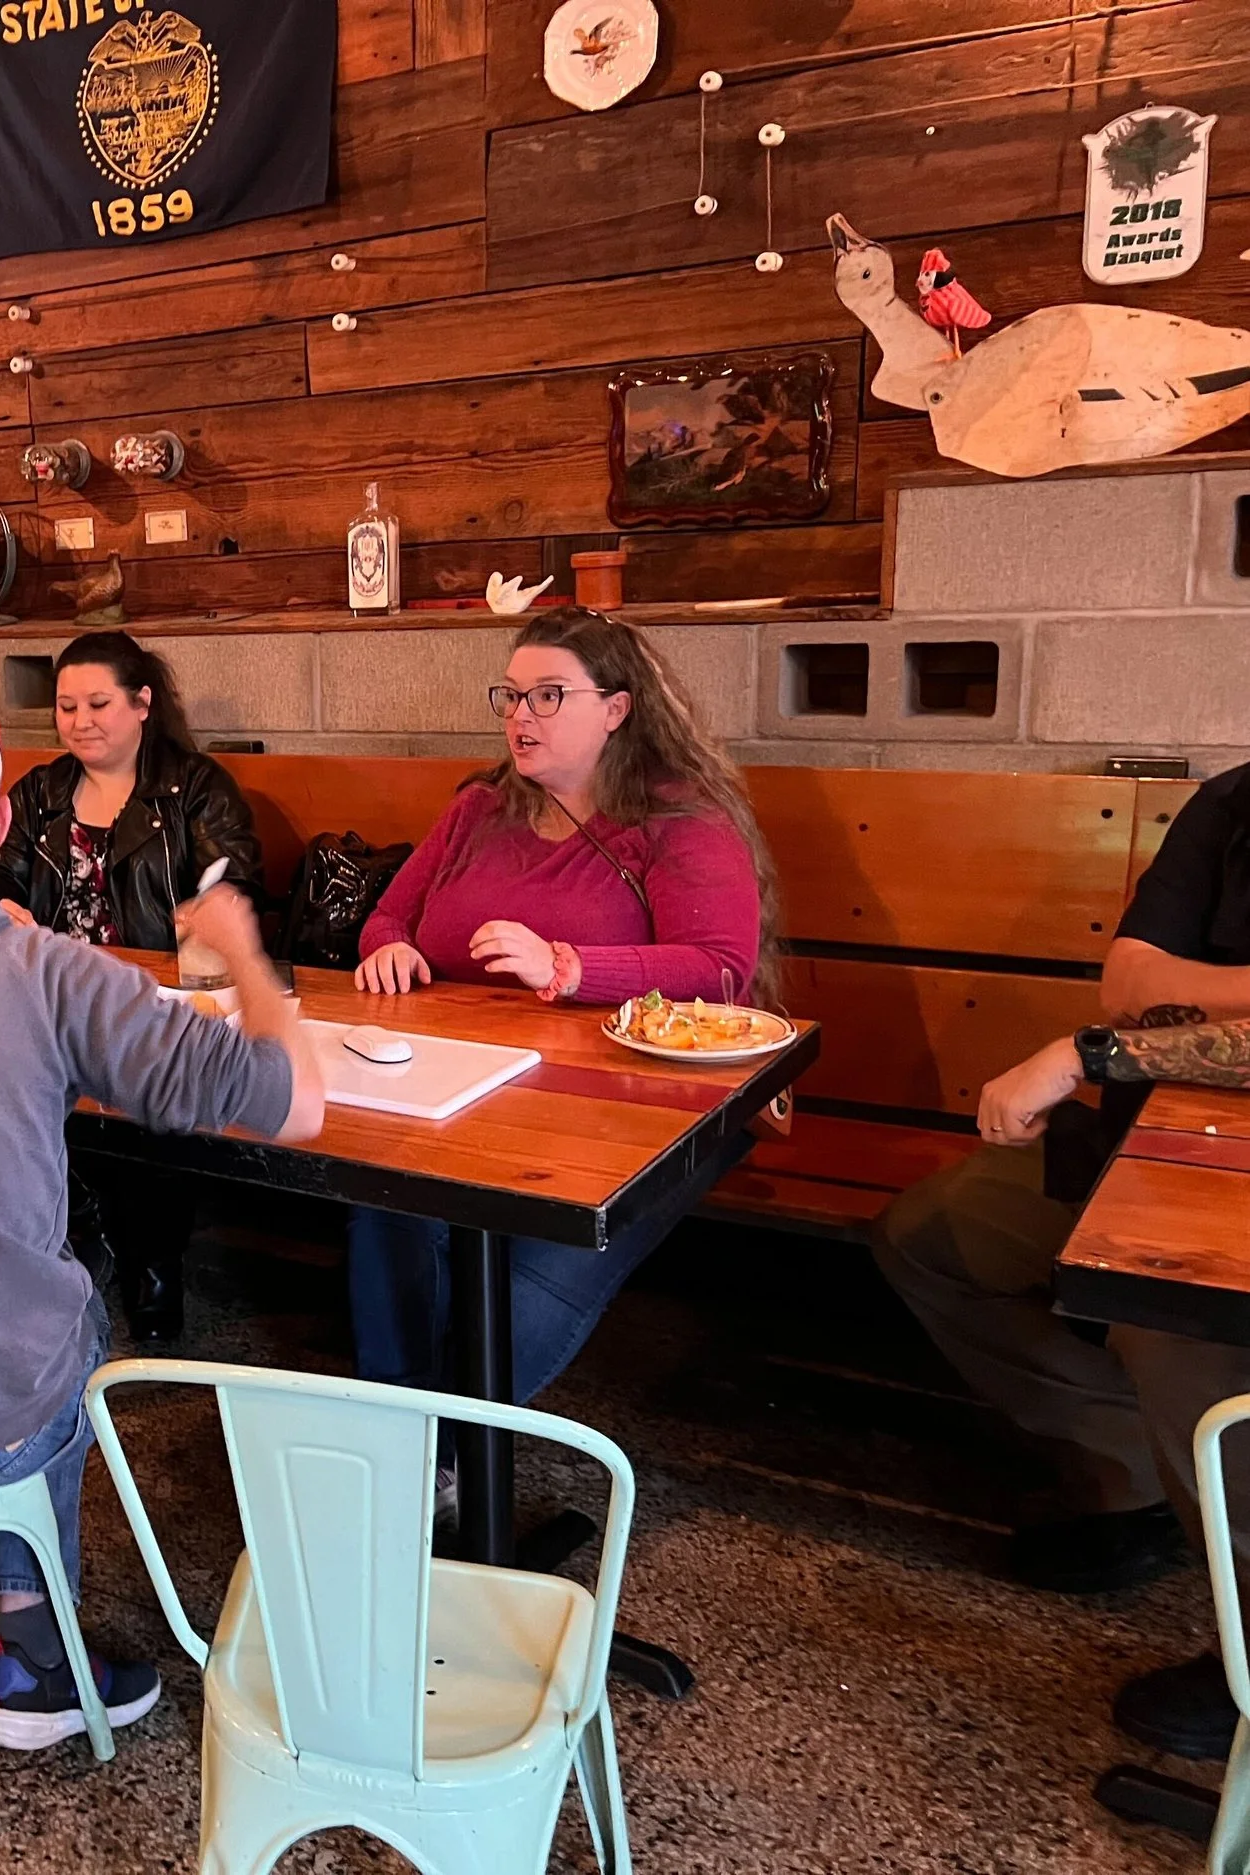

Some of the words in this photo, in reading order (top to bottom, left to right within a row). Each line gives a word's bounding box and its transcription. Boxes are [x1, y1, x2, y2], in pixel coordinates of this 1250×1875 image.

[0, 0, 104, 43] STATE
[91, 188, 194, 237] 1859
[1109, 198, 1182, 226] 2018
[1106, 227, 1182, 249] Awards
[1103, 244, 1183, 267] Banquet
